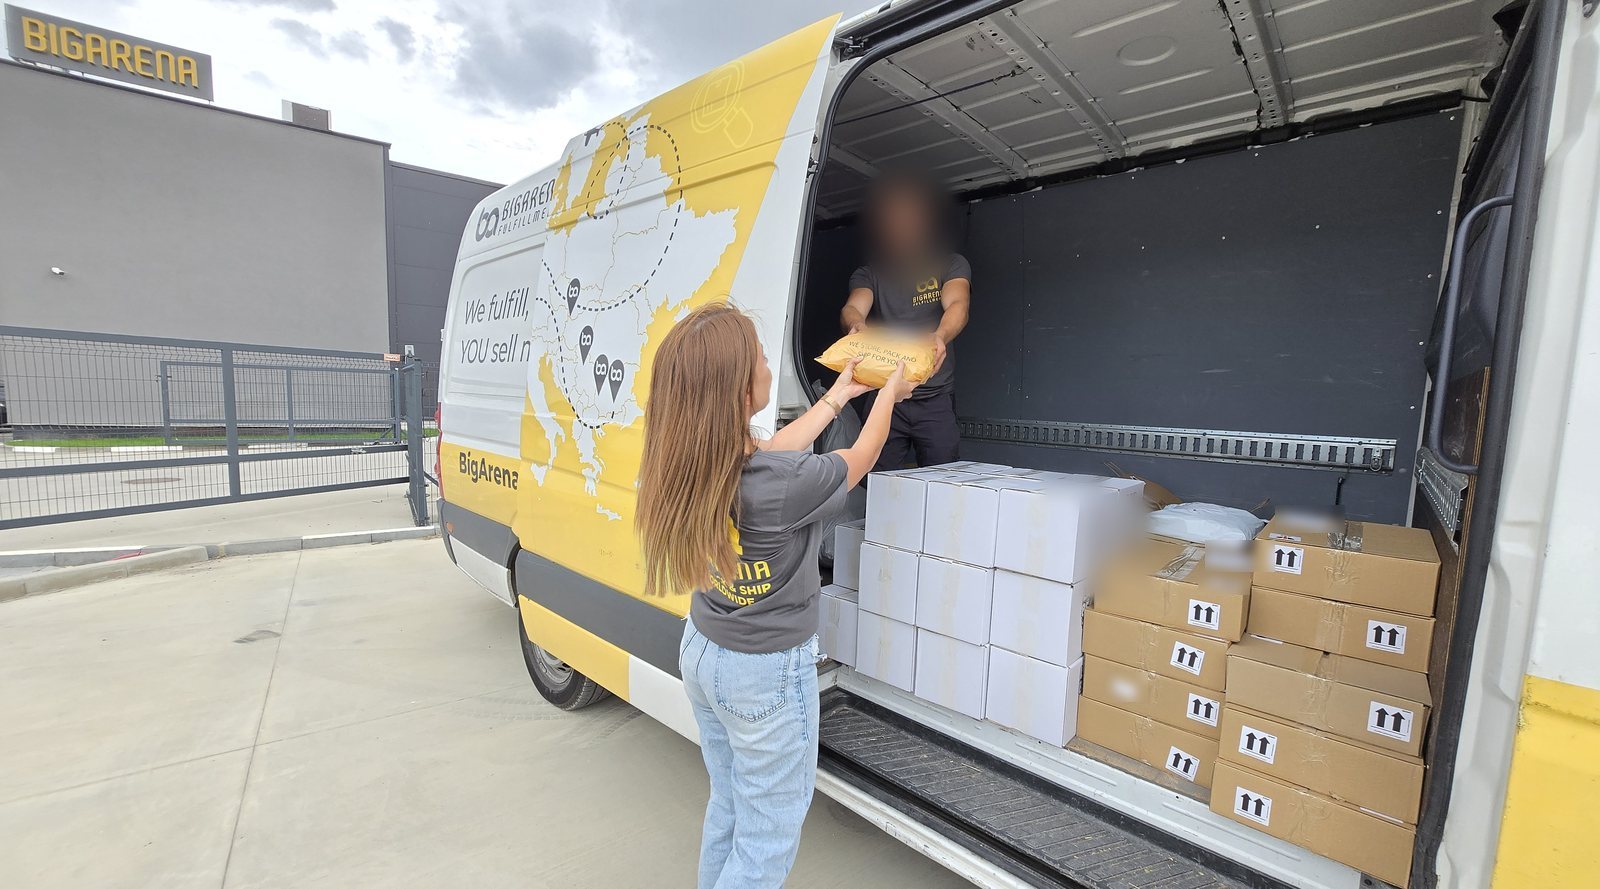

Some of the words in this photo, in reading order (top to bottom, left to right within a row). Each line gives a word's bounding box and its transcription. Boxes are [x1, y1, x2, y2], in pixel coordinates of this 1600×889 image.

[21, 16, 199, 88] BIGARENA
[502, 178, 556, 221] BIGAREN
[497, 207, 550, 236] FULFILLME
[465, 299, 486, 324] We
[487, 287, 530, 321] fulfill,
[461, 338, 490, 364] YOU
[490, 333, 519, 363] sell
[871, 353, 887, 362] FOR
[882, 349, 901, 359] PACK
[901, 355, 917, 363] AND
[459, 451, 519, 491] BigArena
[739, 583, 772, 595] SHIP
